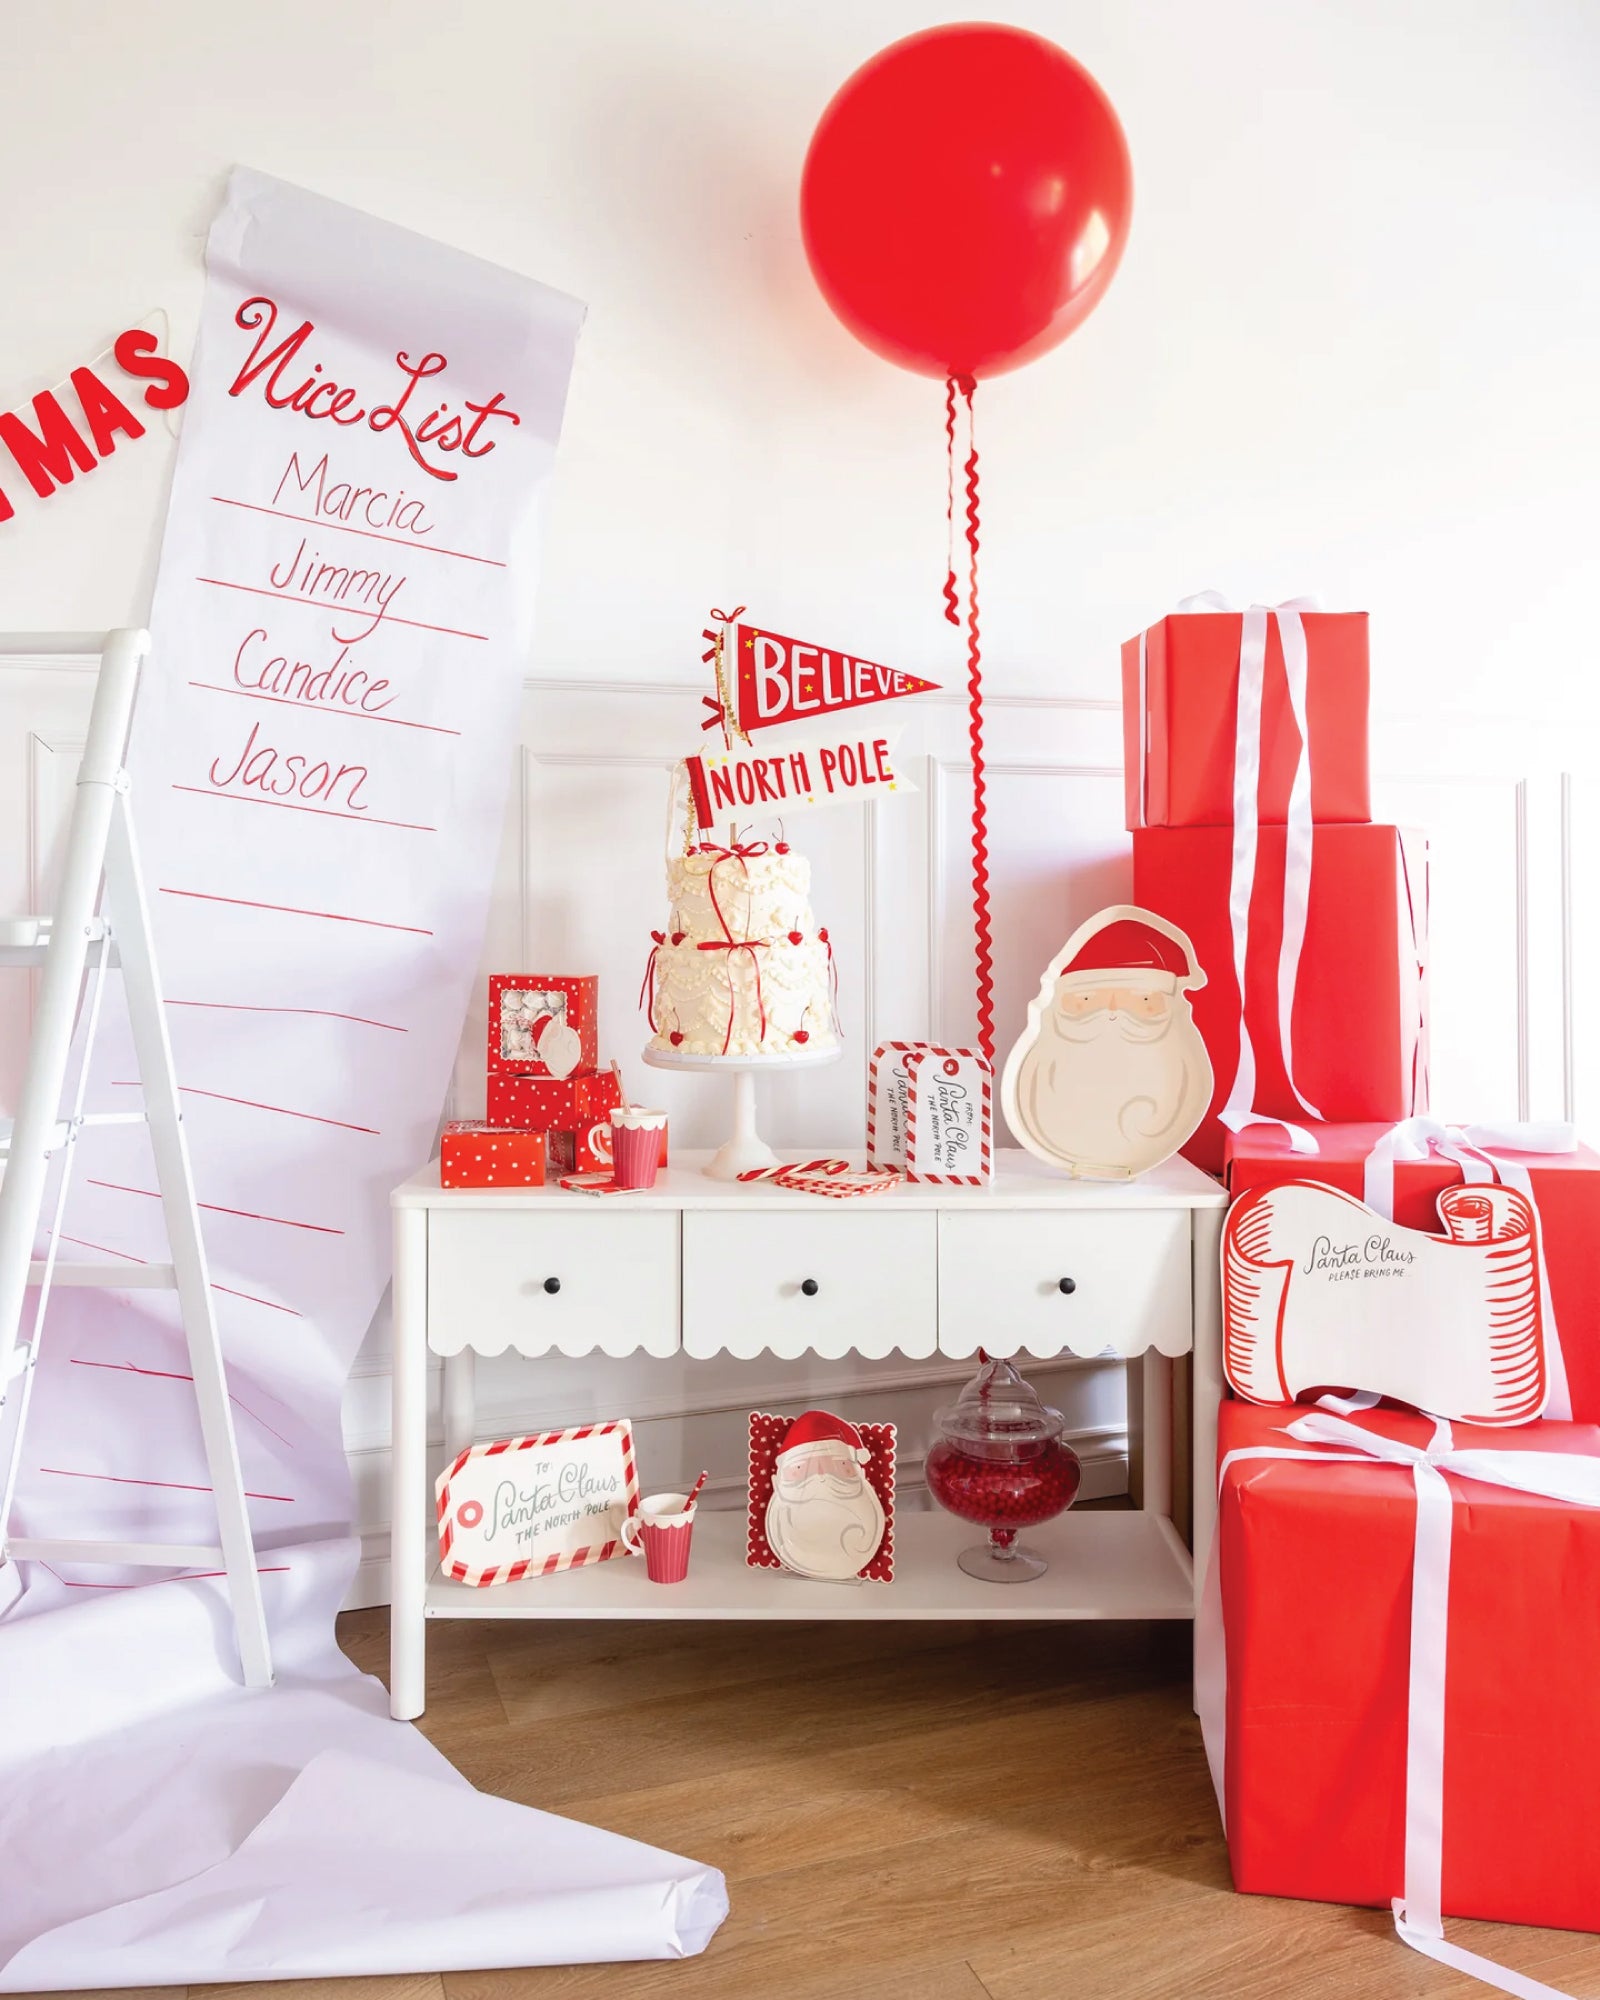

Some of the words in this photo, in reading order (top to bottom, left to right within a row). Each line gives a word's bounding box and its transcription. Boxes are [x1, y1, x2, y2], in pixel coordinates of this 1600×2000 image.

[228, 297, 366, 424] Nice
[367, 351, 520, 481] List
[0, 329, 190, 523] MAS
[272, 451, 435, 535] Marcia
[269, 538, 406, 643] Jimmy
[232, 627, 400, 712] Candice
[753, 635, 907, 719] BELIEVE
[208, 721, 368, 810] Jason
[709, 751, 812, 811] NORTH
[819, 739, 894, 794] POLE
[887, 1088, 895, 1104] THE
[889, 1106, 899, 1133] NORTH
[927, 1095, 938, 1111] THE
[932, 1074, 967, 1126] Santa
[892, 1134, 901, 1153] POLE
[931, 1114, 941, 1141] NORTH
[944, 1126, 970, 1172] Claus
[933, 1143, 942, 1163] POLE
[1303, 1235, 1361, 1275] Santa
[1363, 1234, 1417, 1264] Claus
[1328, 1269, 1361, 1282] PLEASE
[1363, 1268, 1391, 1279] BRING
[484, 1480, 557, 1542] Santa
[558, 1462, 620, 1503] Claus
[515, 1525, 540, 1545] THE
[544, 1510, 581, 1532] NORTH
[584, 1499, 611, 1517] POLE
